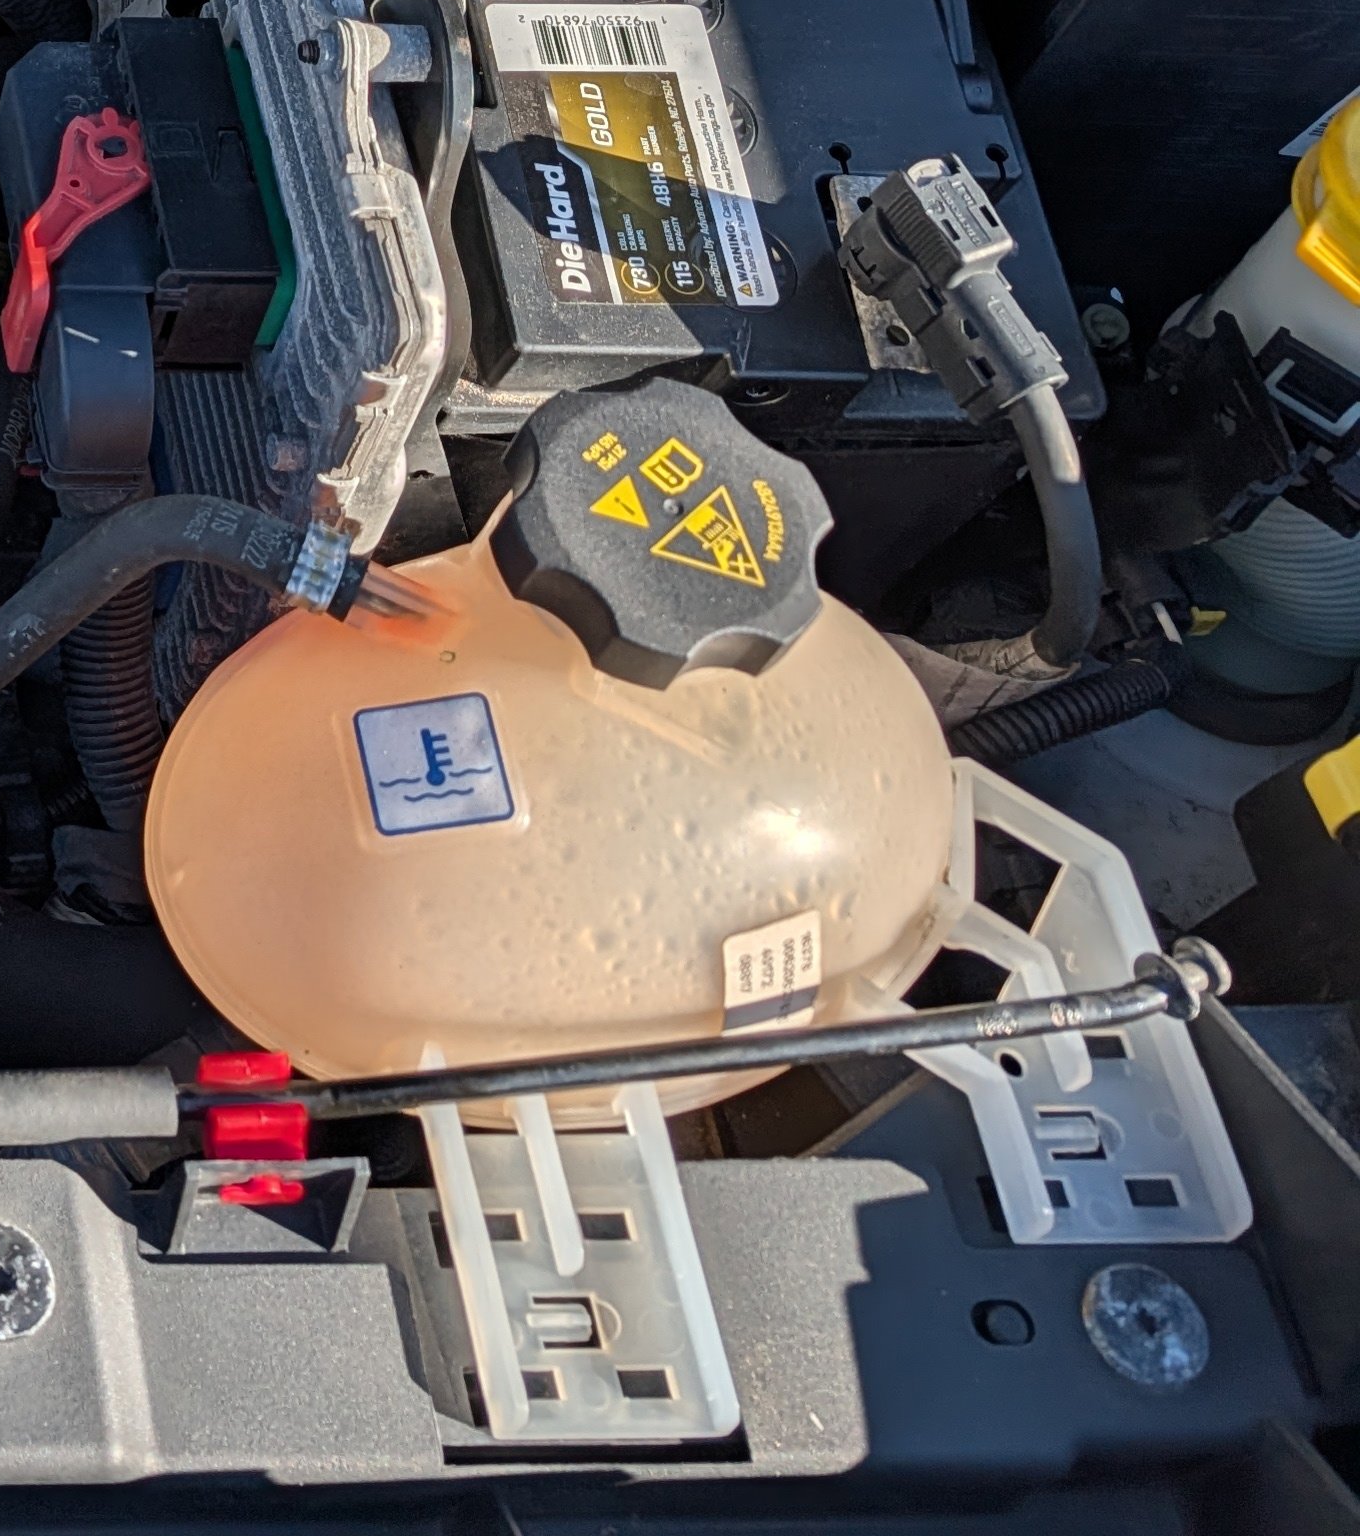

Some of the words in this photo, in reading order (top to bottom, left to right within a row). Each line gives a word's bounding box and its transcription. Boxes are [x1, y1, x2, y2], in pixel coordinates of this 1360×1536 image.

[518, 14, 526, 24] 2
[544, 15, 592, 26] 76810
[596, 15, 642, 26] 92350
[579, 82, 614, 148] GOLD
[667, 106, 680, 119] NC
[639, 136, 652, 155] PART
[647, 125, 661, 155] NUMBER
[699, 122, 719, 172] Reproductive
[680, 152, 695, 177] Parts,
[649, 160, 672, 208] 48H6
[686, 178, 699, 198] Auto
[711, 173, 724, 189] and
[534, 162, 592, 293] DieHard
[691, 199, 709, 234] Advance
[615, 231, 629, 251] COLD
[621, 212, 638, 251] CRANKING
[635, 228, 649, 251] AMPS
[661, 218, 676, 251] RESERVE
[669, 215, 686, 251] CAPACITY
[737, 228, 751, 246] after
[723, 220, 749, 282] WARNING:
[742, 247, 758, 273] hands
[626, 256, 652, 289] 730
[671, 261, 695, 287] 115
[706, 250, 725, 297] Distributed
[749, 273, 765, 297] Wash
[596, 451, 619, 473] PSI
